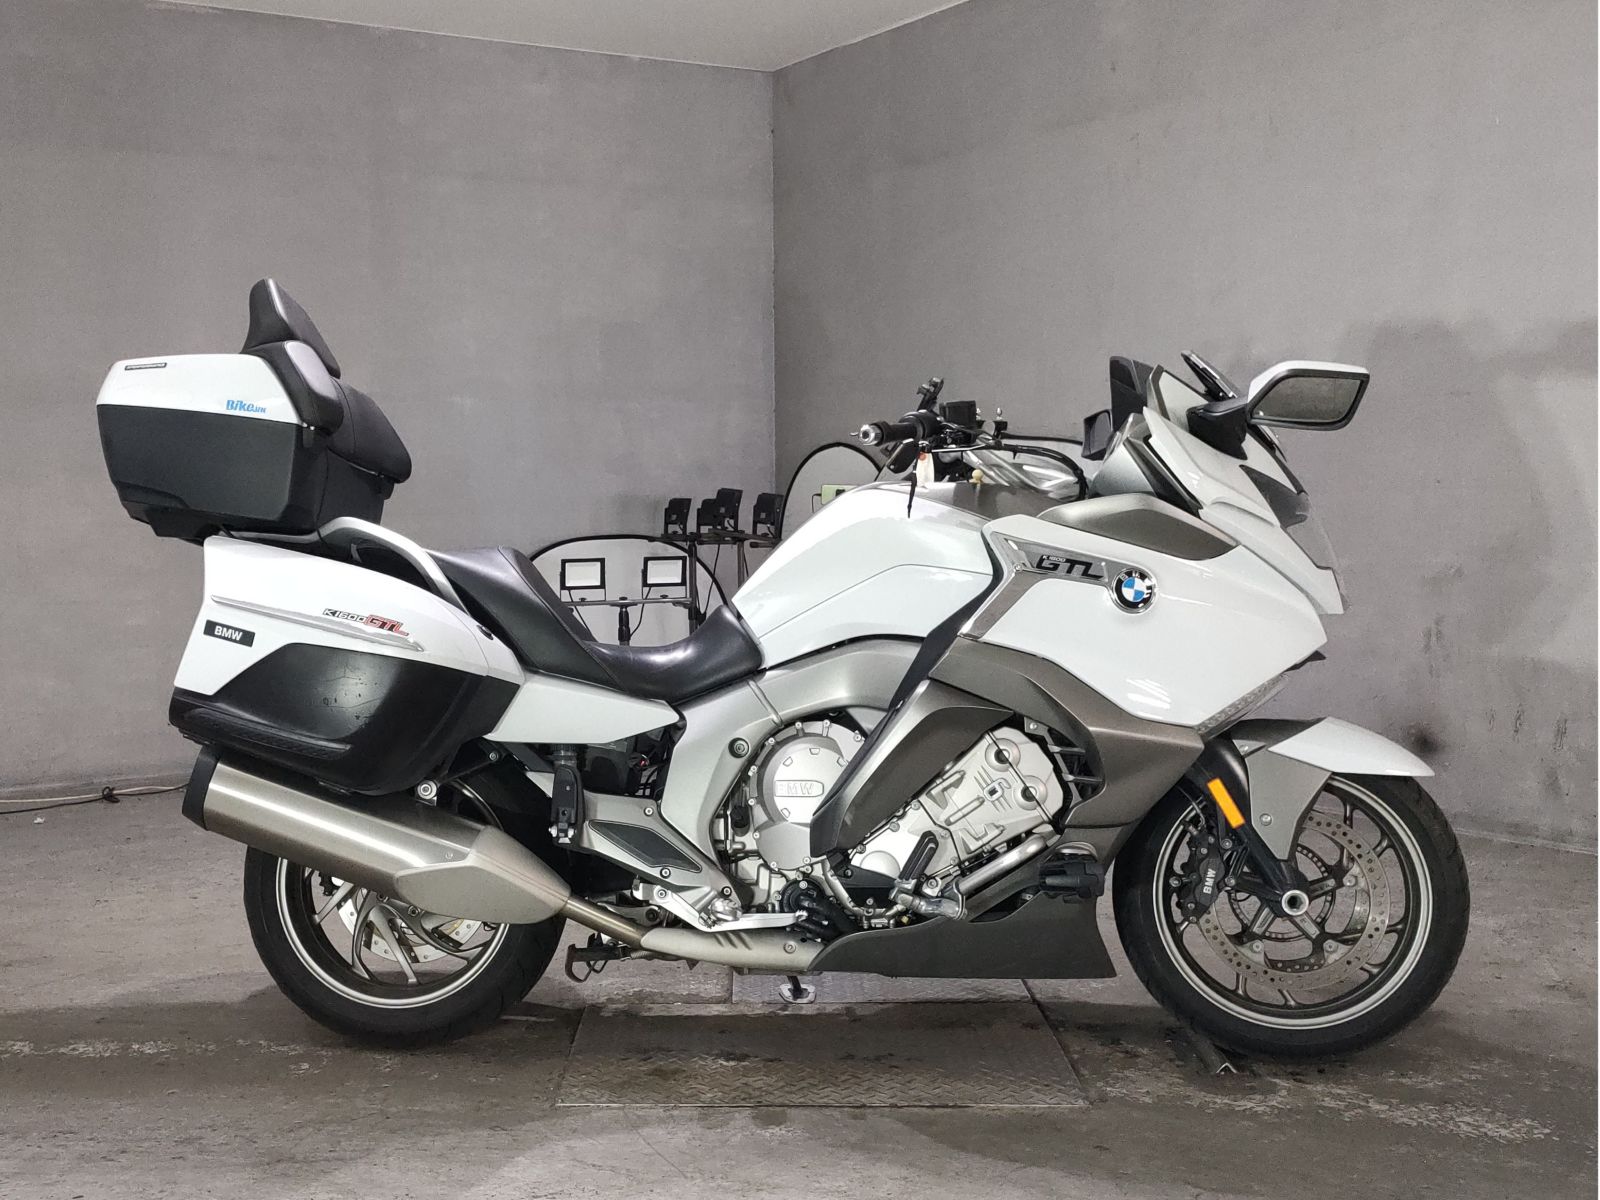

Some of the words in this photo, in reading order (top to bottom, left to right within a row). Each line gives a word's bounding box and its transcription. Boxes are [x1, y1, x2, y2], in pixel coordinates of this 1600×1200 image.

[1036, 555, 1104, 580] GTL
[214, 625, 243, 642] BMW
[365, 614, 410, 636] GTL
[777, 783, 814, 795] BMW
[1203, 868, 1216, 894] BMW
